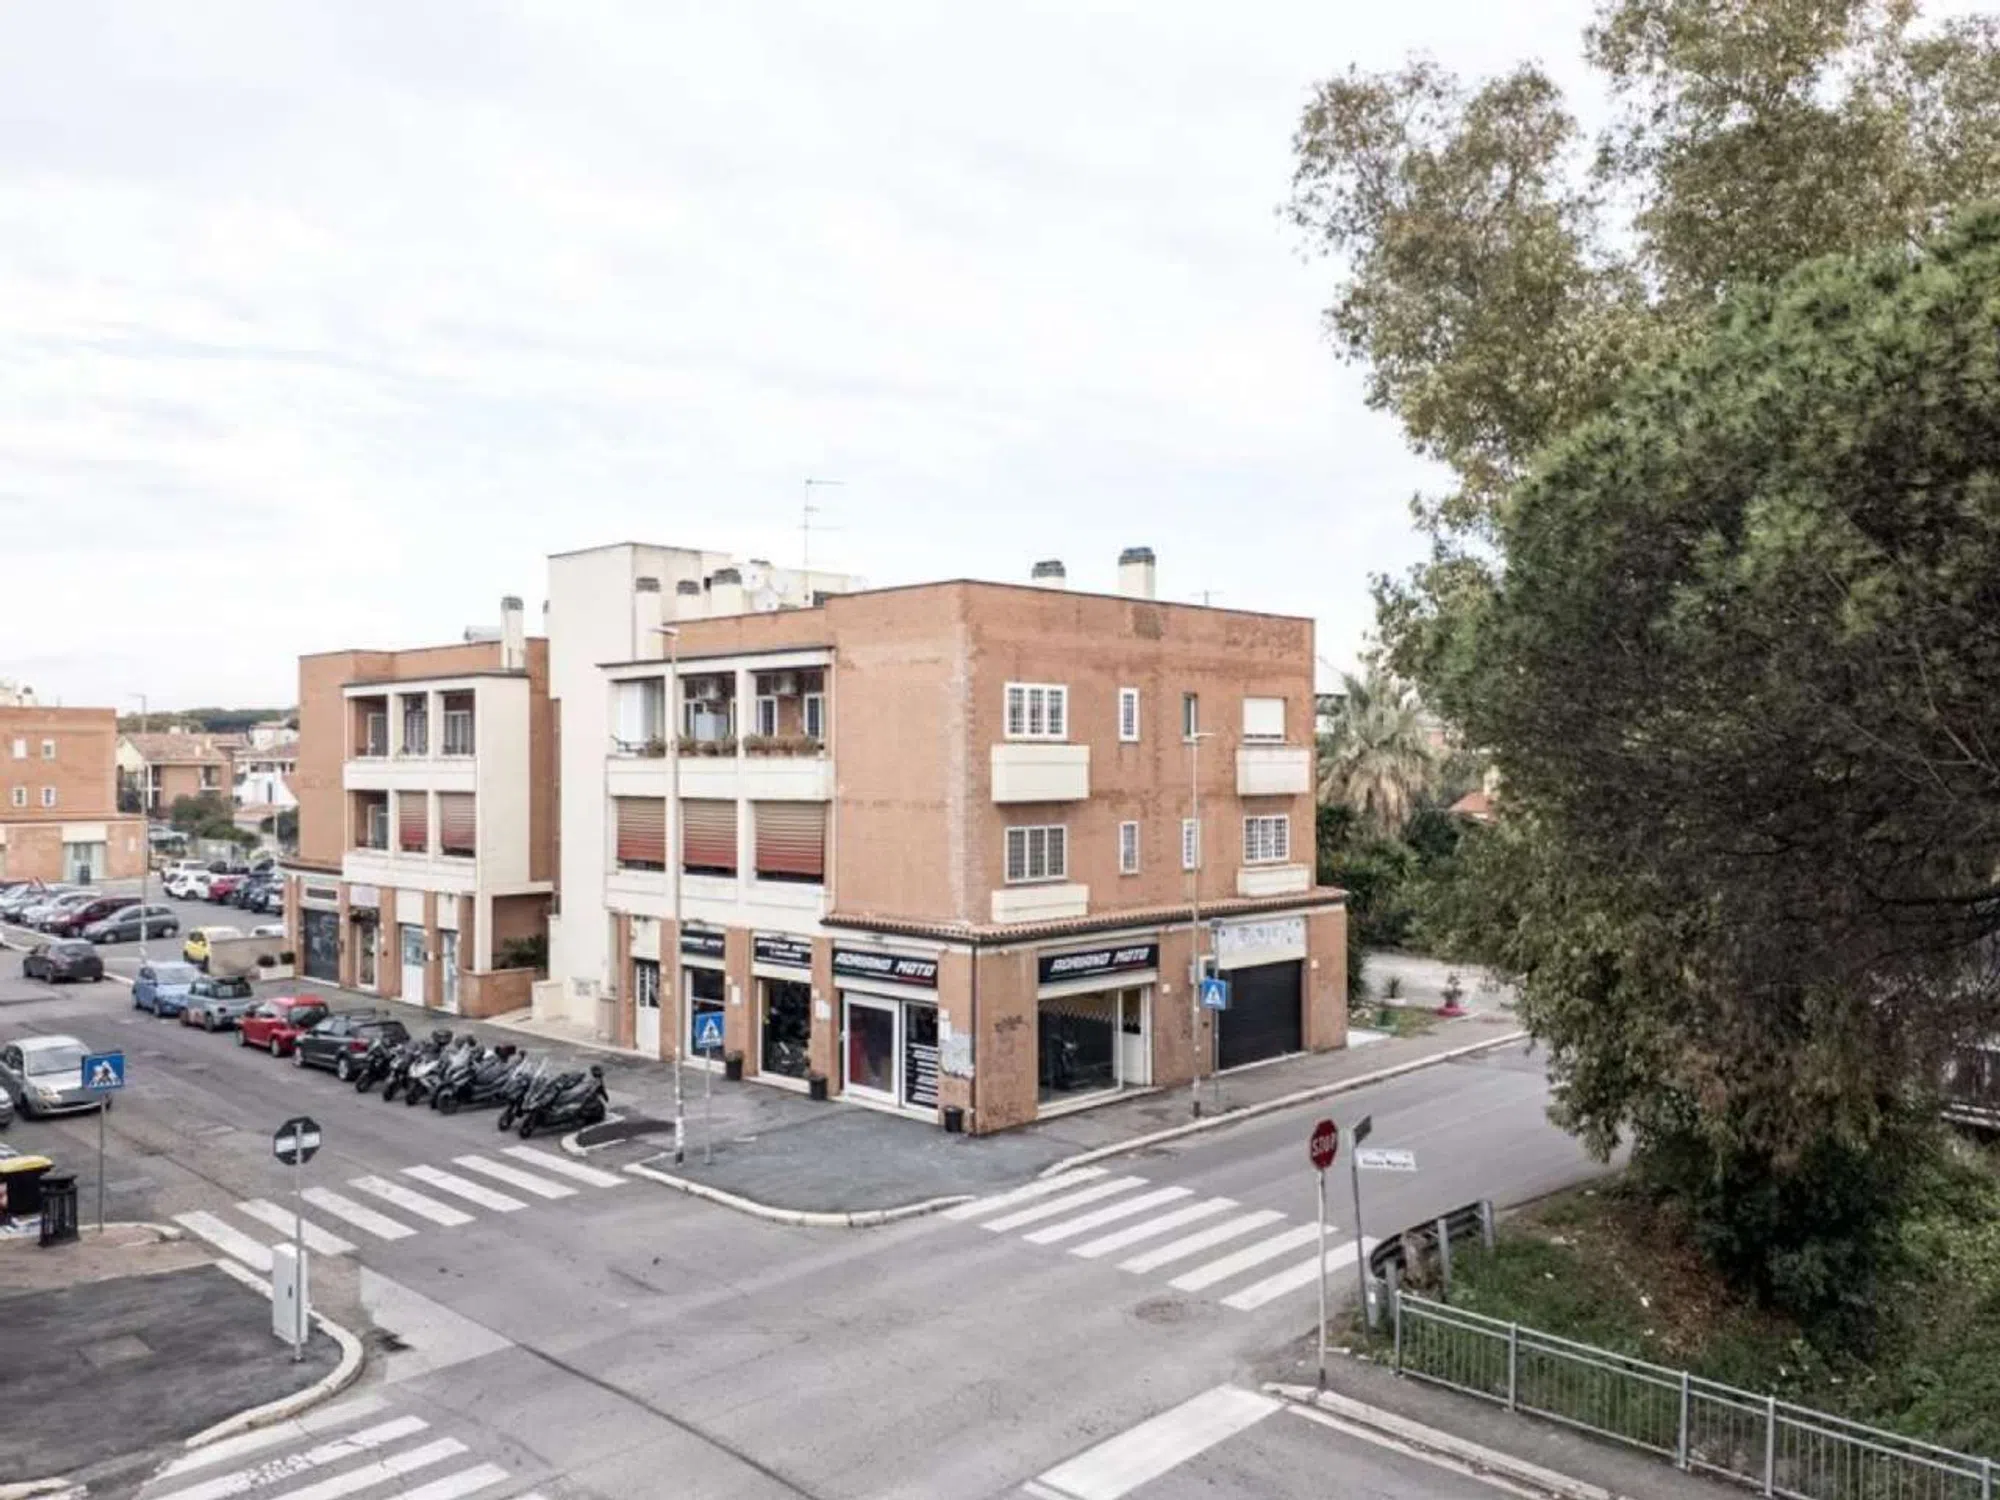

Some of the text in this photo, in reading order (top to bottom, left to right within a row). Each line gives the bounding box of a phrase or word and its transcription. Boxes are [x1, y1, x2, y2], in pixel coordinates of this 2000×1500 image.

[1112, 947, 1150, 964] MOTO
[895, 960, 937, 977] MOTO
[1312, 1132, 1336, 1157] STOP
